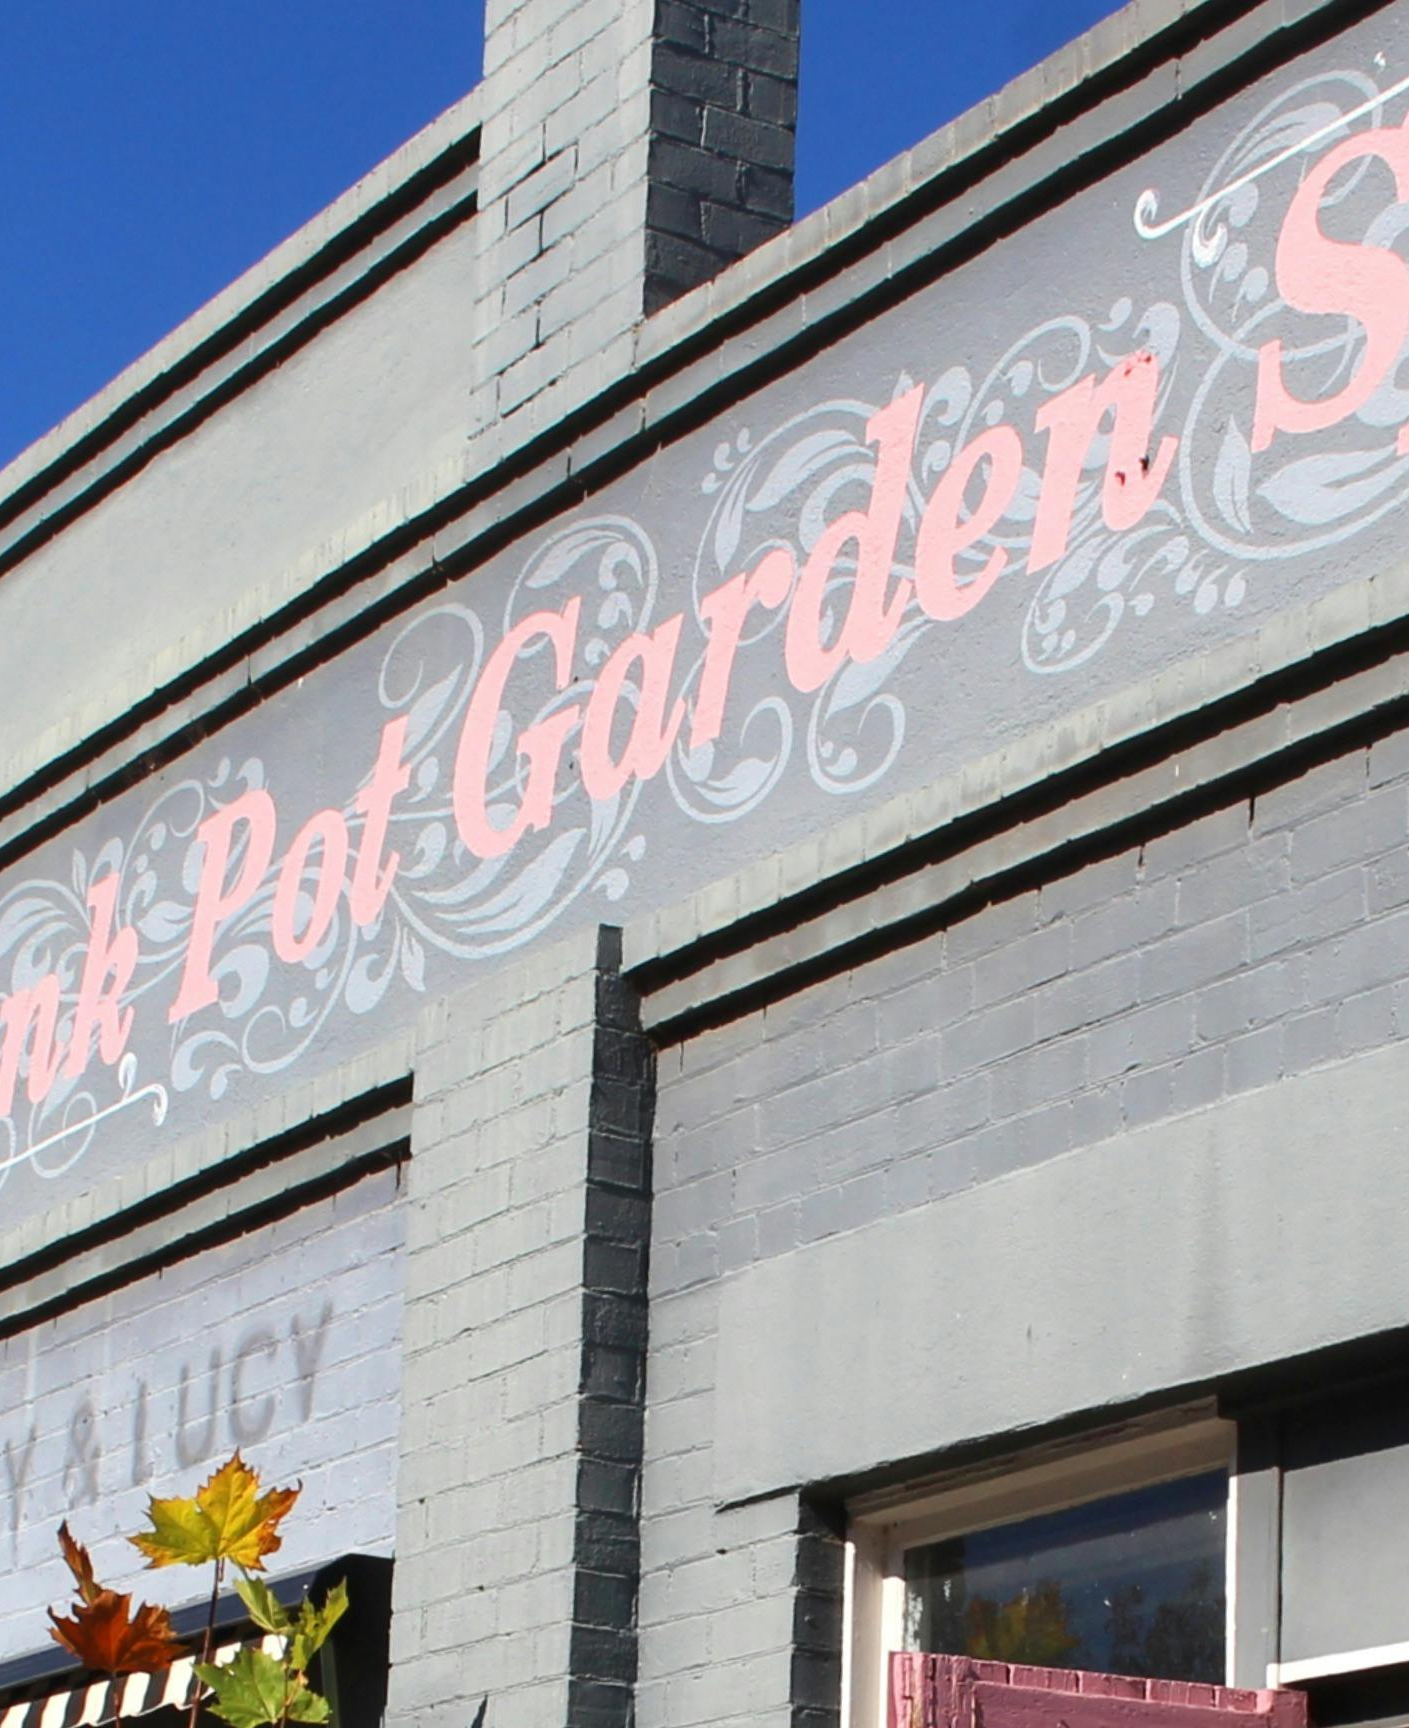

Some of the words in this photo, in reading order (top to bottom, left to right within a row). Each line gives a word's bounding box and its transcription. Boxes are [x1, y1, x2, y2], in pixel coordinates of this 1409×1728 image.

[168, 714, 411, 1024] Pot
[453, 350, 1179, 859] Garden
[63, 1398, 102, 1506] &
[131, 1299, 334, 1490] LUCY
